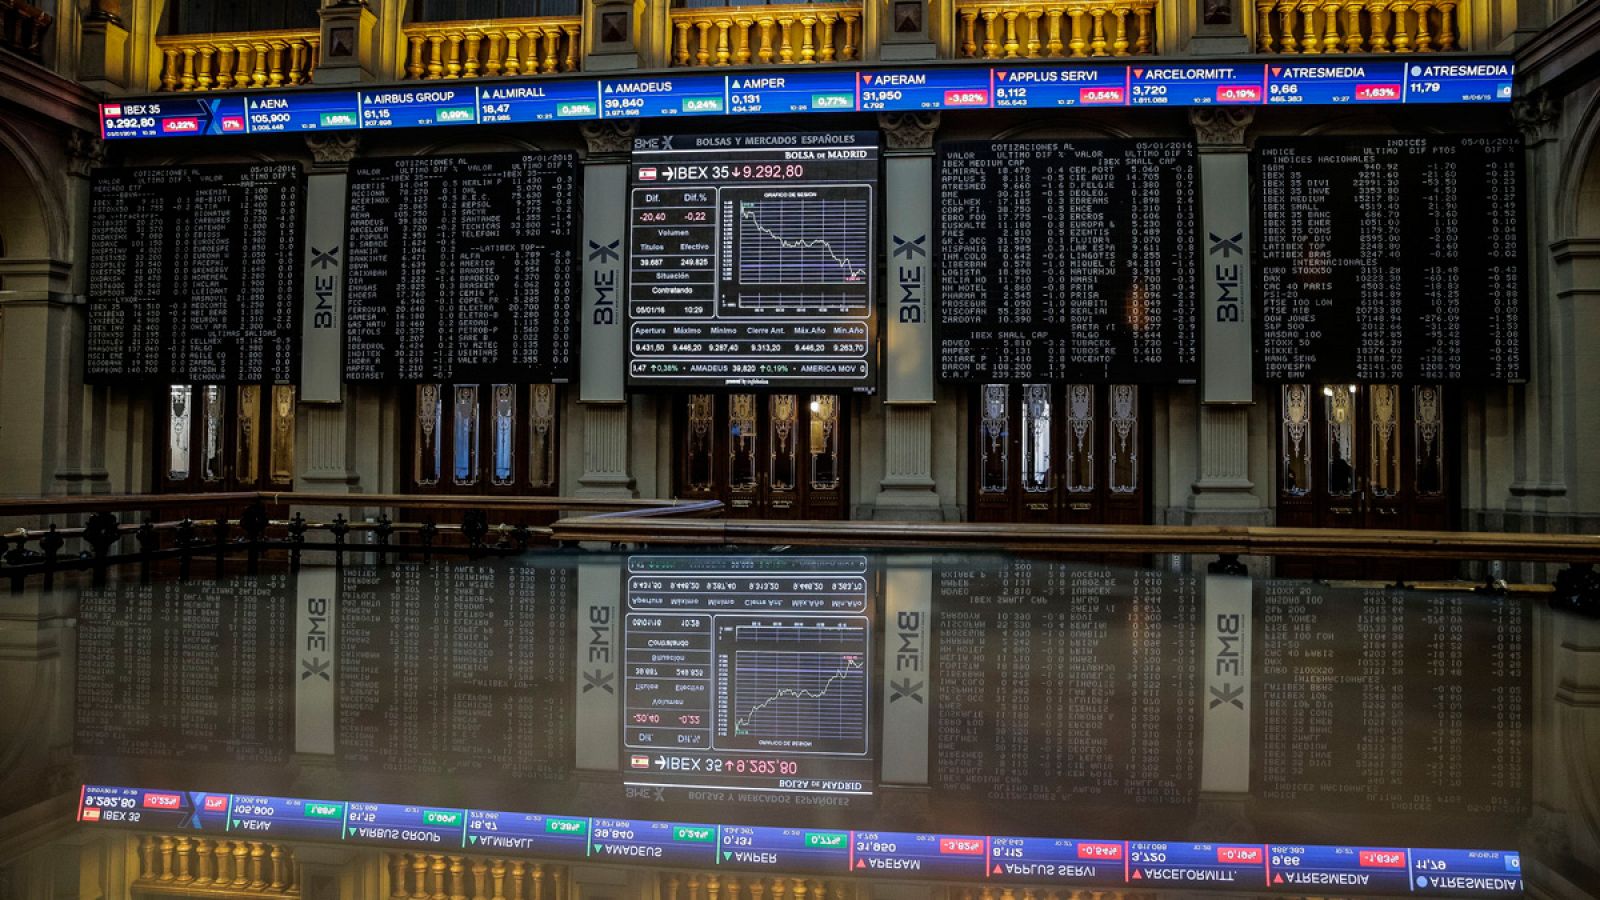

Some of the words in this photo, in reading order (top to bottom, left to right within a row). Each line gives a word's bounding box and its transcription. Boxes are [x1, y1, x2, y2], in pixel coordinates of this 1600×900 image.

[1145, 69, 1236, 79] ARCELORMITT.
[1284, 68, 1365, 78] ATRESMEDIA
[1424, 66, 1508, 76] ATRESMEDIA
[875, 75, 926, 85] APERAM
[1009, 72, 1058, 82] APPLUS
[1061, 71, 1098, 81] SERVI
[616, 82, 672, 93] AMADEUS
[743, 78, 785, 89] AMPER
[1410, 82, 1440, 93] 11,79
[493, 88, 545, 98] ALMIRALL
[996, 88, 1027, 98] 8,112
[1084, 91, 1119, 100] -0,54%
[1132, 86, 1167, 95] 3,720
[1221, 89, 1256, 99] -0,19%
[1270, 85, 1298, 94] 9,66
[1360, 88, 1395, 98] -1,63%
[374, 93, 414, 103] AIRBUS
[416, 91, 454, 102] GROUP
[731, 95, 761, 104] 0,131
[818, 97, 847, 106] 0,77%
[863, 91, 902, 101] 31,950
[260, 99, 288, 108] AENA
[604, 98, 644, 108] 39,840
[688, 100, 716, 110] 0,24%
[124, 105, 145, 115] IBEX
[148, 105, 160, 114] 35
[482, 104, 510, 114] 18,47
[251, 113, 290, 123] 105,900
[364, 110, 390, 119] 61,15
[106, 118, 156, 129] 9.292,80
[166, 121, 196, 129] -0,22%
[634, 138, 659, 148] BME
[696, 137, 731, 146] BOLSAS
[735, 137, 741, 145] Y
[745, 136, 797, 145] MERCADOS
[801, 134, 855, 144] ESPAÑOLES
[785, 151, 815, 159] BOLSA
[827, 150, 867, 158] MADRID
[674, 167, 708, 180] IBEX
[712, 167, 729, 178] 35
[743, 165, 803, 179] 9.292,80
[646, 194, 660, 202] Dif.
[684, 193, 707, 202] Dif.%
[639, 212, 666, 222] -20,40
[684, 212, 706, 221] -0,22
[656, 272, 690, 280] Situación
[594, 269, 615, 325] BME
[900, 266, 921, 324] BME
[1216, 265, 1238, 322] BME
[314, 275, 333, 328] BME
[635, 327, 666, 335] Apertura
[657, 364, 678, 372] 0,38%
[732, 365, 756, 373] 39,820
[766, 365, 788, 373] 0,19%
